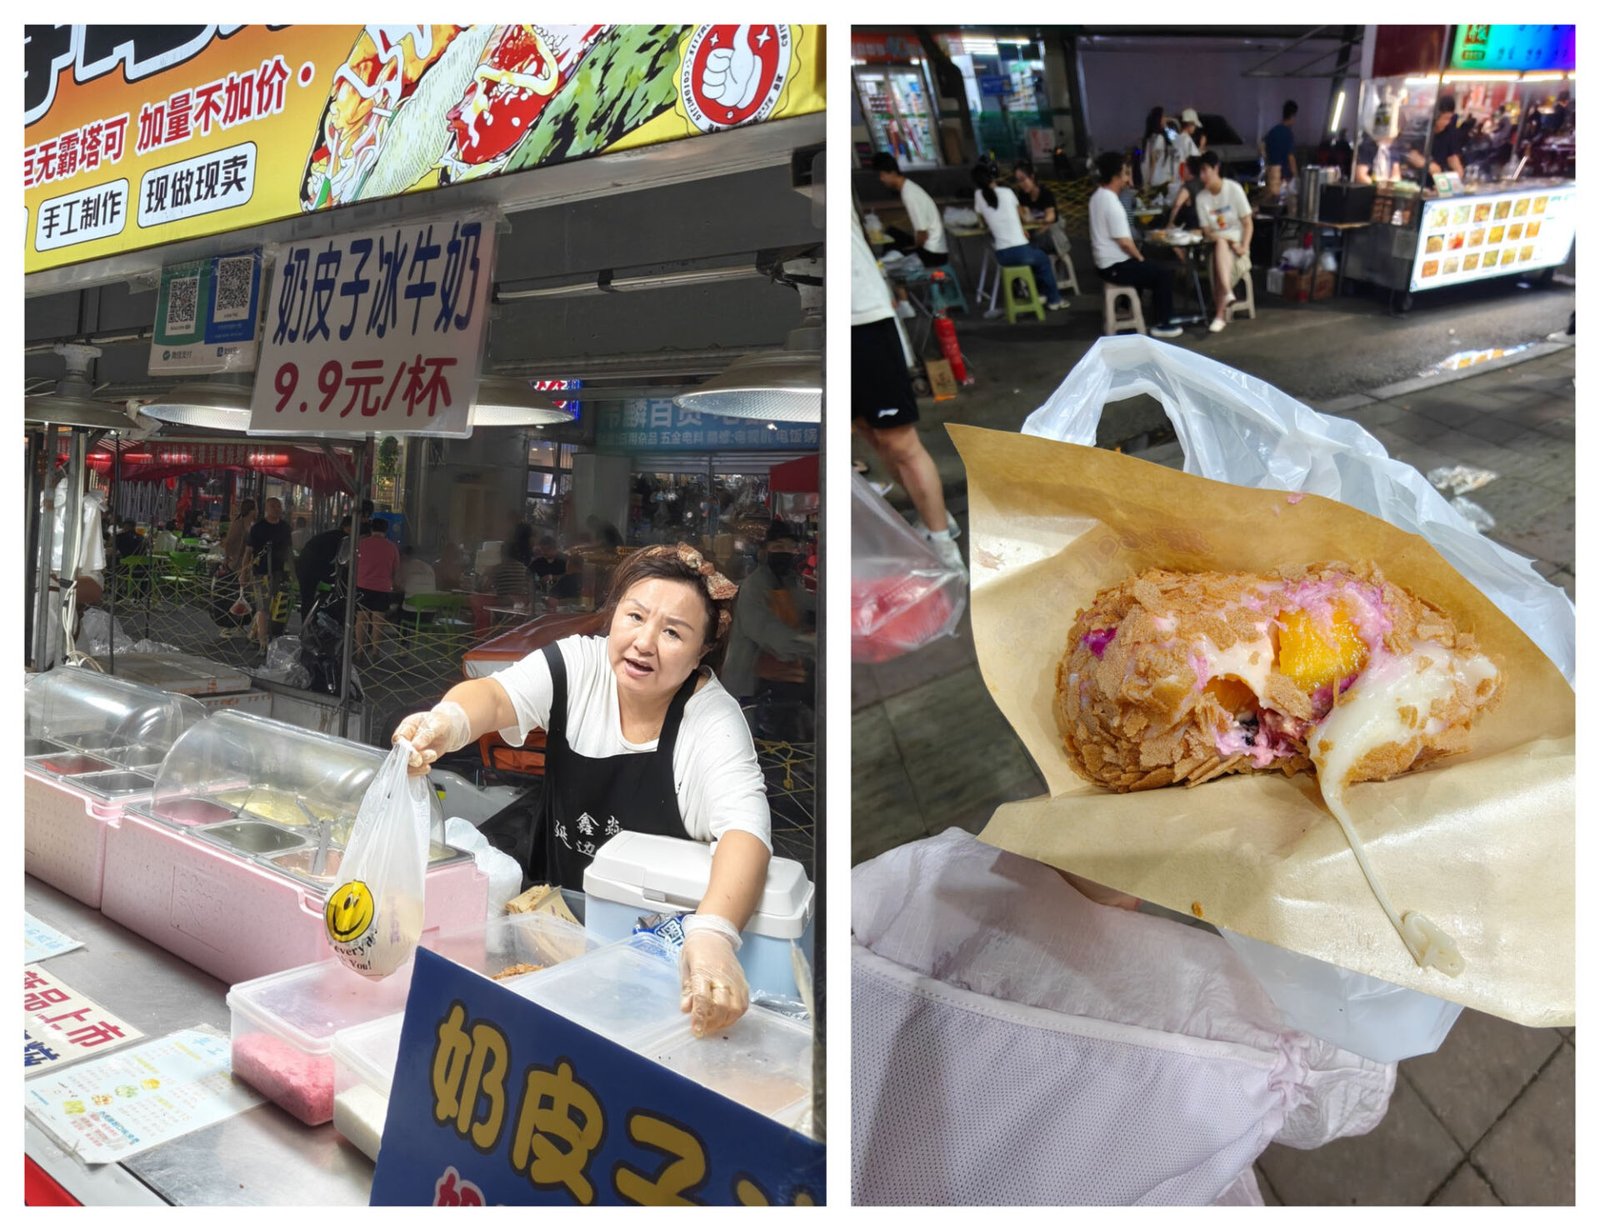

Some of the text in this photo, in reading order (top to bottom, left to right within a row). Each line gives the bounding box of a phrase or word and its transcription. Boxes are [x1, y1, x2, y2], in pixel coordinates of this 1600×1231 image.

[137, 59, 289, 151] 加量不加价
[42, 190, 122, 239] 手工制作
[145, 154, 248, 214] 现做现卖
[272, 221, 482, 346] 奶皮子冰牛奶
[274, 353, 458, 418] 9.9元/杯
[334, 944, 365, 956] every
[432, 1004, 816, 1207] 奶皮子
